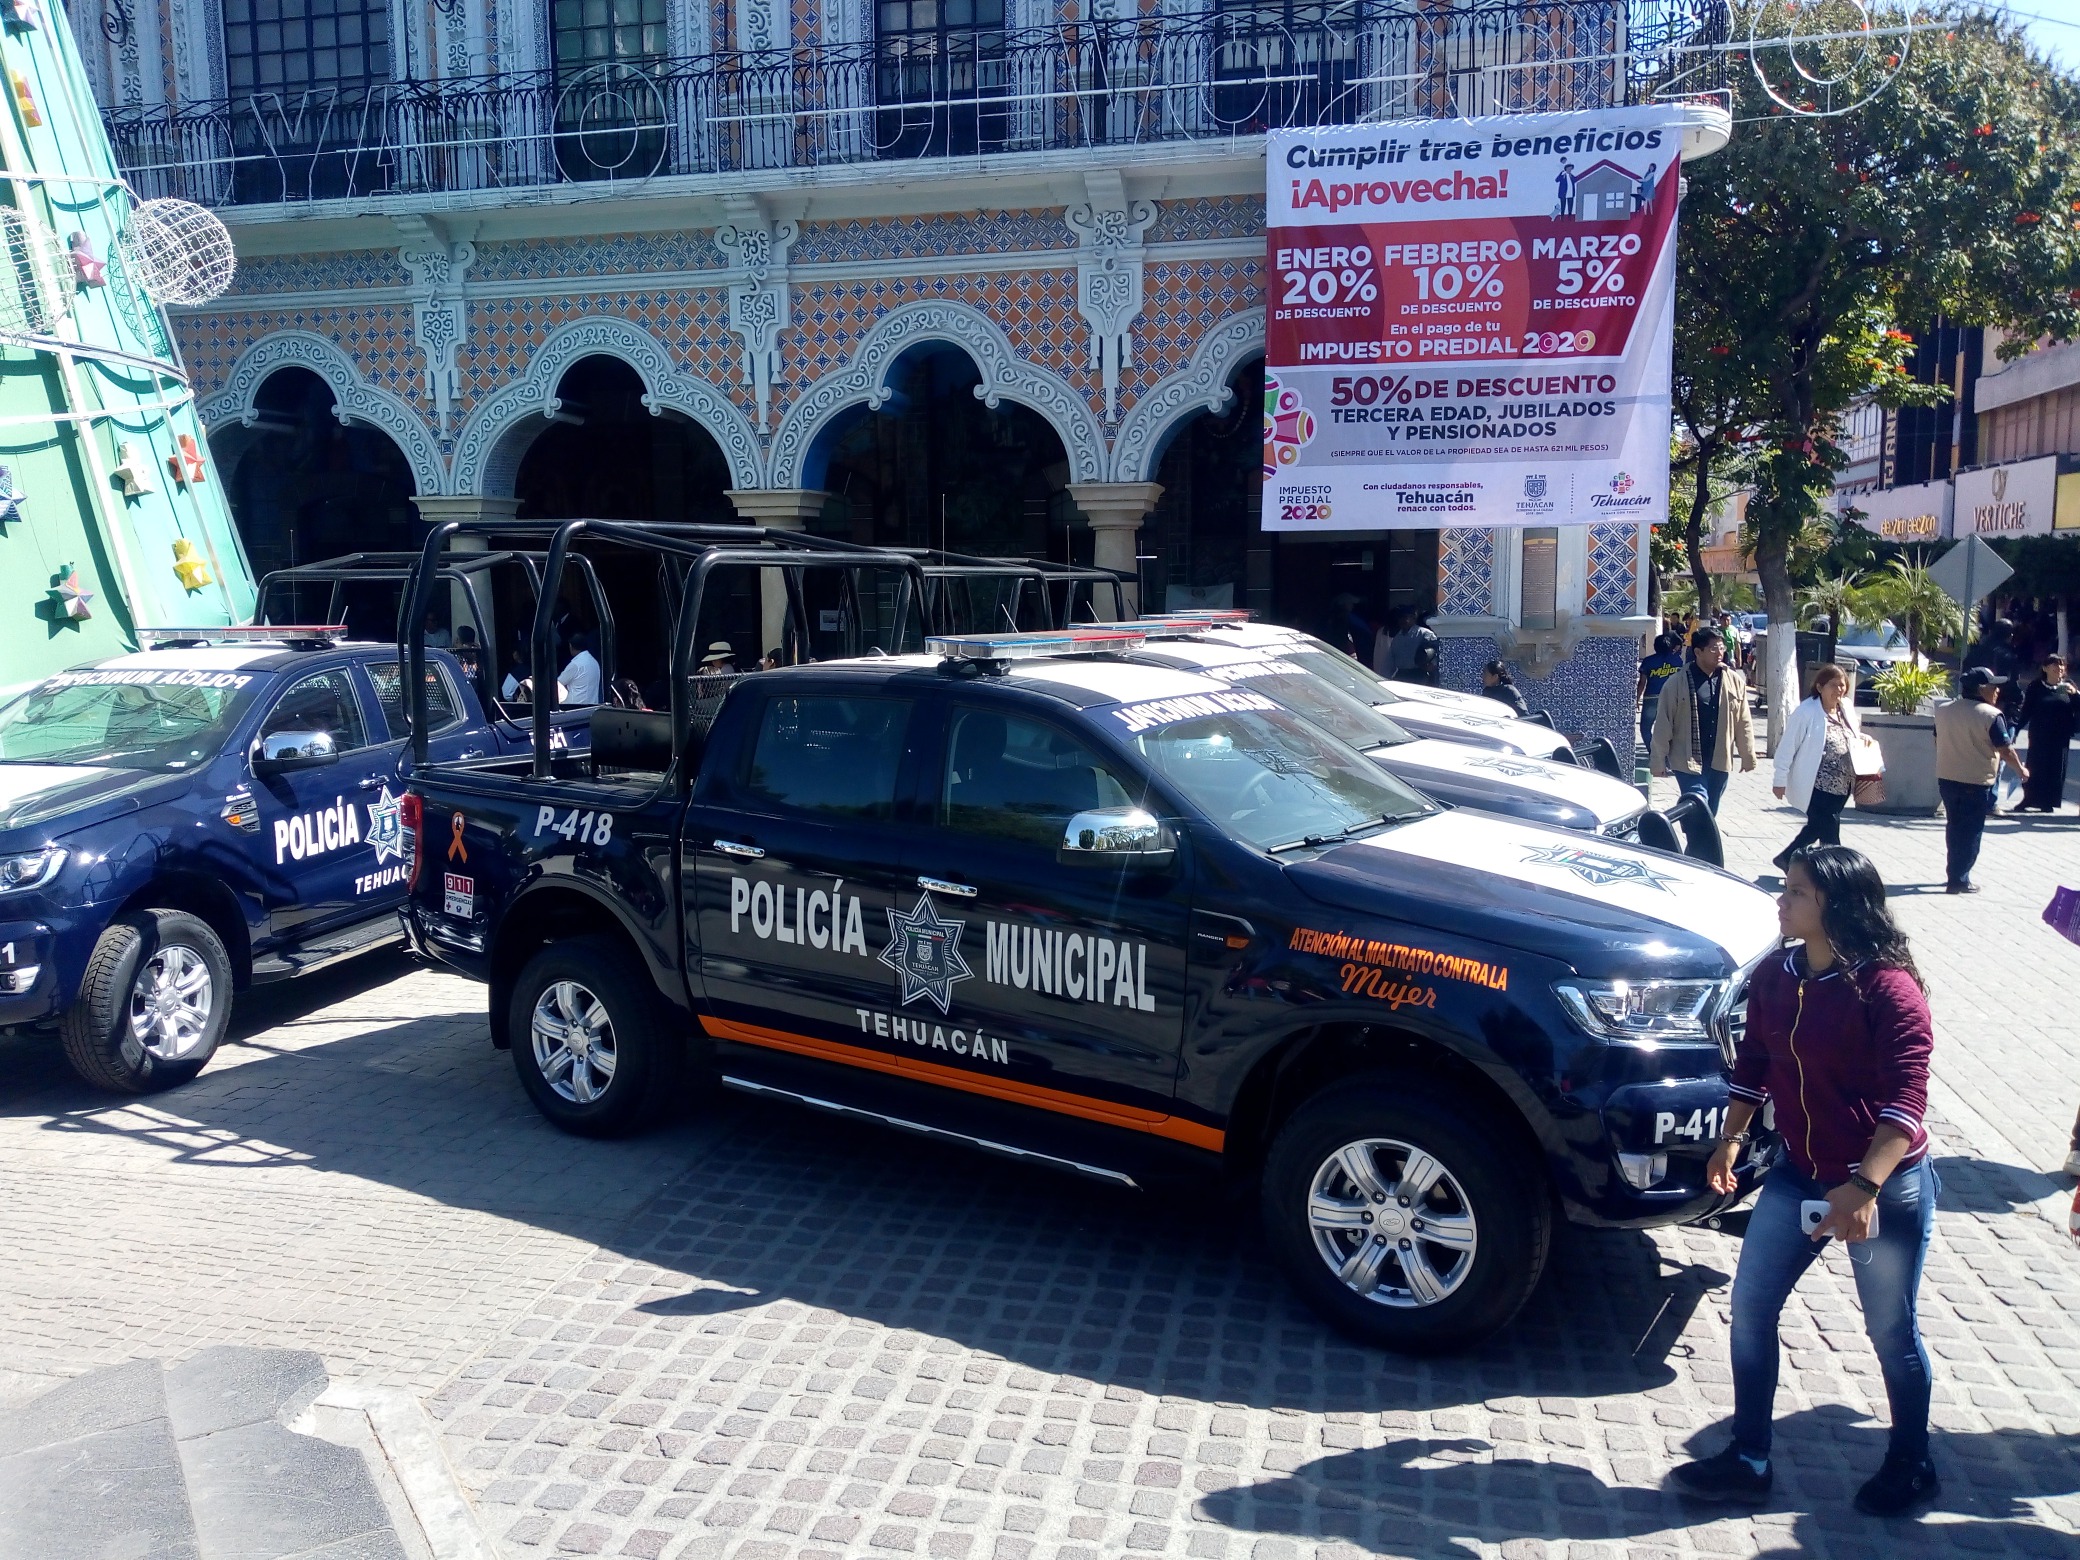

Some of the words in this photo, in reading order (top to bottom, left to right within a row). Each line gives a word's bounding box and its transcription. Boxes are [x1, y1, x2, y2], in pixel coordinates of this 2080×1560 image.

[1287, 141, 1411, 171] Cumplir
[1420, 138, 1480, 163] trae
[1491, 127, 1662, 158] beneficios
[1291, 169, 1509, 213] ¡Aprovecha!
[1277, 245, 1372, 270] ENERO
[1385, 239, 1522, 266] FEBRERO
[1532, 233, 1641, 260] MARZO
[1282, 269, 1378, 305] 20%
[1413, 264, 1504, 300] 10%
[1556, 258, 1625, 295] 5%
[1275, 310, 1292, 320] DE
[1294, 306, 1371, 319] DESCUENTO
[1400, 304, 1418, 315] DE
[1421, 302, 1502, 314] DESCUENTO
[1533, 299, 1551, 310] DE
[1553, 296, 1636, 309] DESCUENTO
[1390, 323, 1410, 335] En
[1412, 322, 1423, 334] el
[1426, 324, 1461, 338] pago
[1464, 321, 1483, 333] de
[1485, 321, 1500, 332] tu
[1300, 340, 1413, 360] IMPUESTO
[1418, 336, 1518, 356] PREDIAL
[1522, 330, 1597, 354] 2020
[1331, 375, 1413, 406] 50%
[1415, 380, 1449, 398] DE
[1456, 374, 1617, 397] DESCUENTO
[1331, 407, 1424, 424] TERCERA
[1430, 404, 1492, 424] EDAD,
[1497, 401, 1616, 419] JUBILADOS
[1387, 424, 1400, 441] Y
[1406, 421, 1557, 441] PENSIONADOS
[1331, 450, 1366, 458] (SIEMPRE
[1448, 447, 1492, 455] PROPIEDAD
[1523, 445, 1549, 453] HASTA
[1580, 443, 1609, 452] PESOS)
[1279, 485, 1332, 495] IMPUESTO
[1279, 495, 1332, 504] PREDIAL
[1381, 482, 1427, 490] ciudadanos
[1428, 481, 1484, 491] responsables,
[1396, 489, 1474, 504] Tehuacán
[1281, 505, 1332, 521] 2020
[1448, 504, 1476, 512] todos.
[1590, 494, 1652, 508] Tehuacán
[1973, 501, 2026, 533] VERTICHE
[274, 795, 360, 865] POLICÍA
[534, 805, 614, 847] P-418
[354, 864, 407, 895] TEHUAC
[447, 877, 471, 893] 911
[731, 878, 868, 957] POLICÍA
[986, 920, 1156, 1013] MUNICIPAL
[1288, 927, 1351, 959] ATENCIÓN
[1348, 937, 1364, 962] AL
[1364, 940, 1434, 976] MALTRATO
[1433, 952, 1489, 986] CONTRA
[1487, 966, 1508, 992] LA
[1340, 963, 1438, 1011] Mujer
[856, 1008, 1009, 1065] TEHUACÁN
